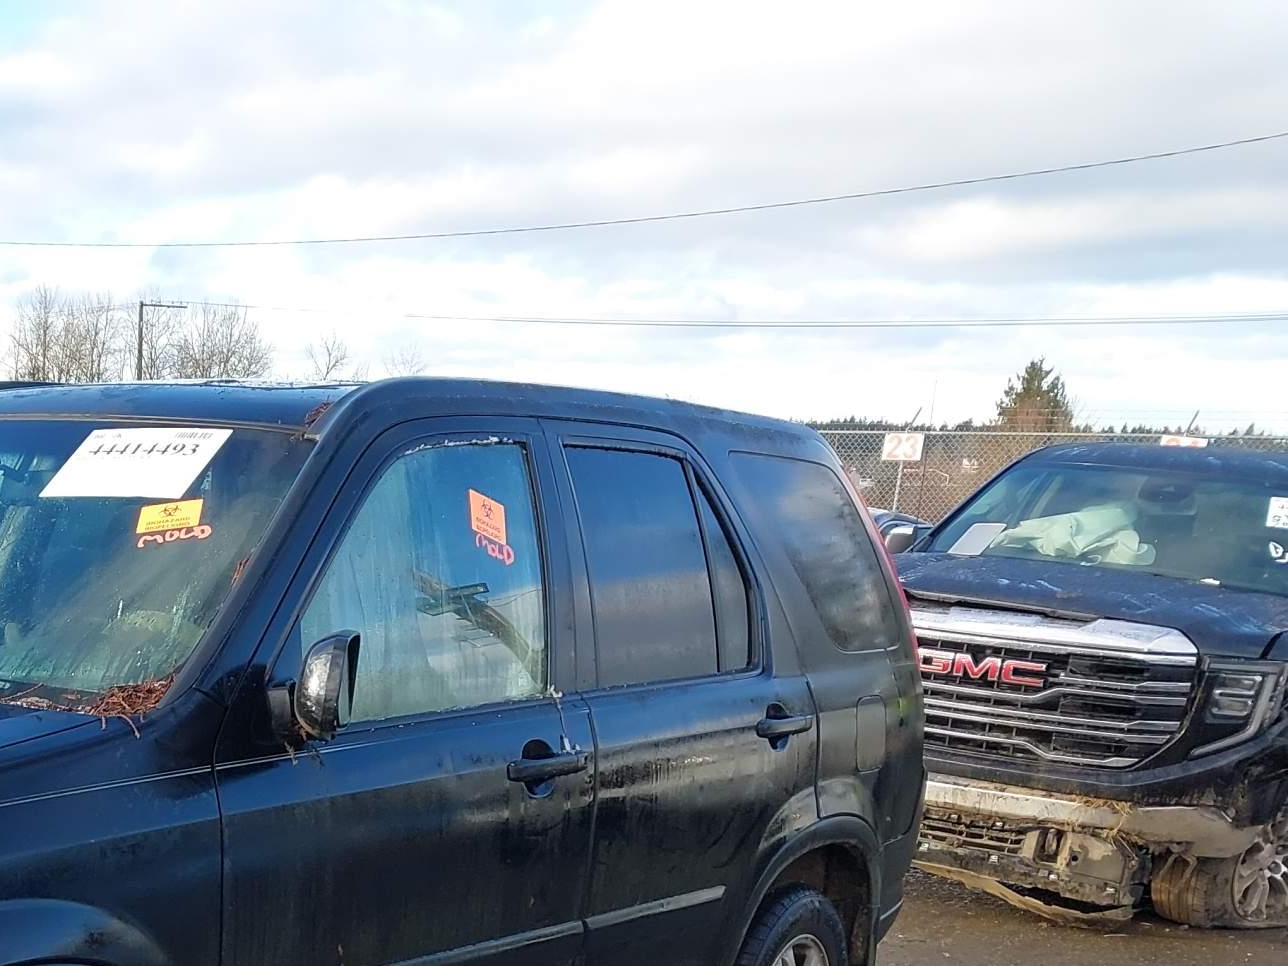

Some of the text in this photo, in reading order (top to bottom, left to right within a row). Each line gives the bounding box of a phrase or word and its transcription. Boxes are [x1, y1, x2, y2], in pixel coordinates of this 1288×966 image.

[89, 442, 201, 456] 44414493
[887, 434, 918, 459] 23
[918, 647, 1049, 688] GMC
